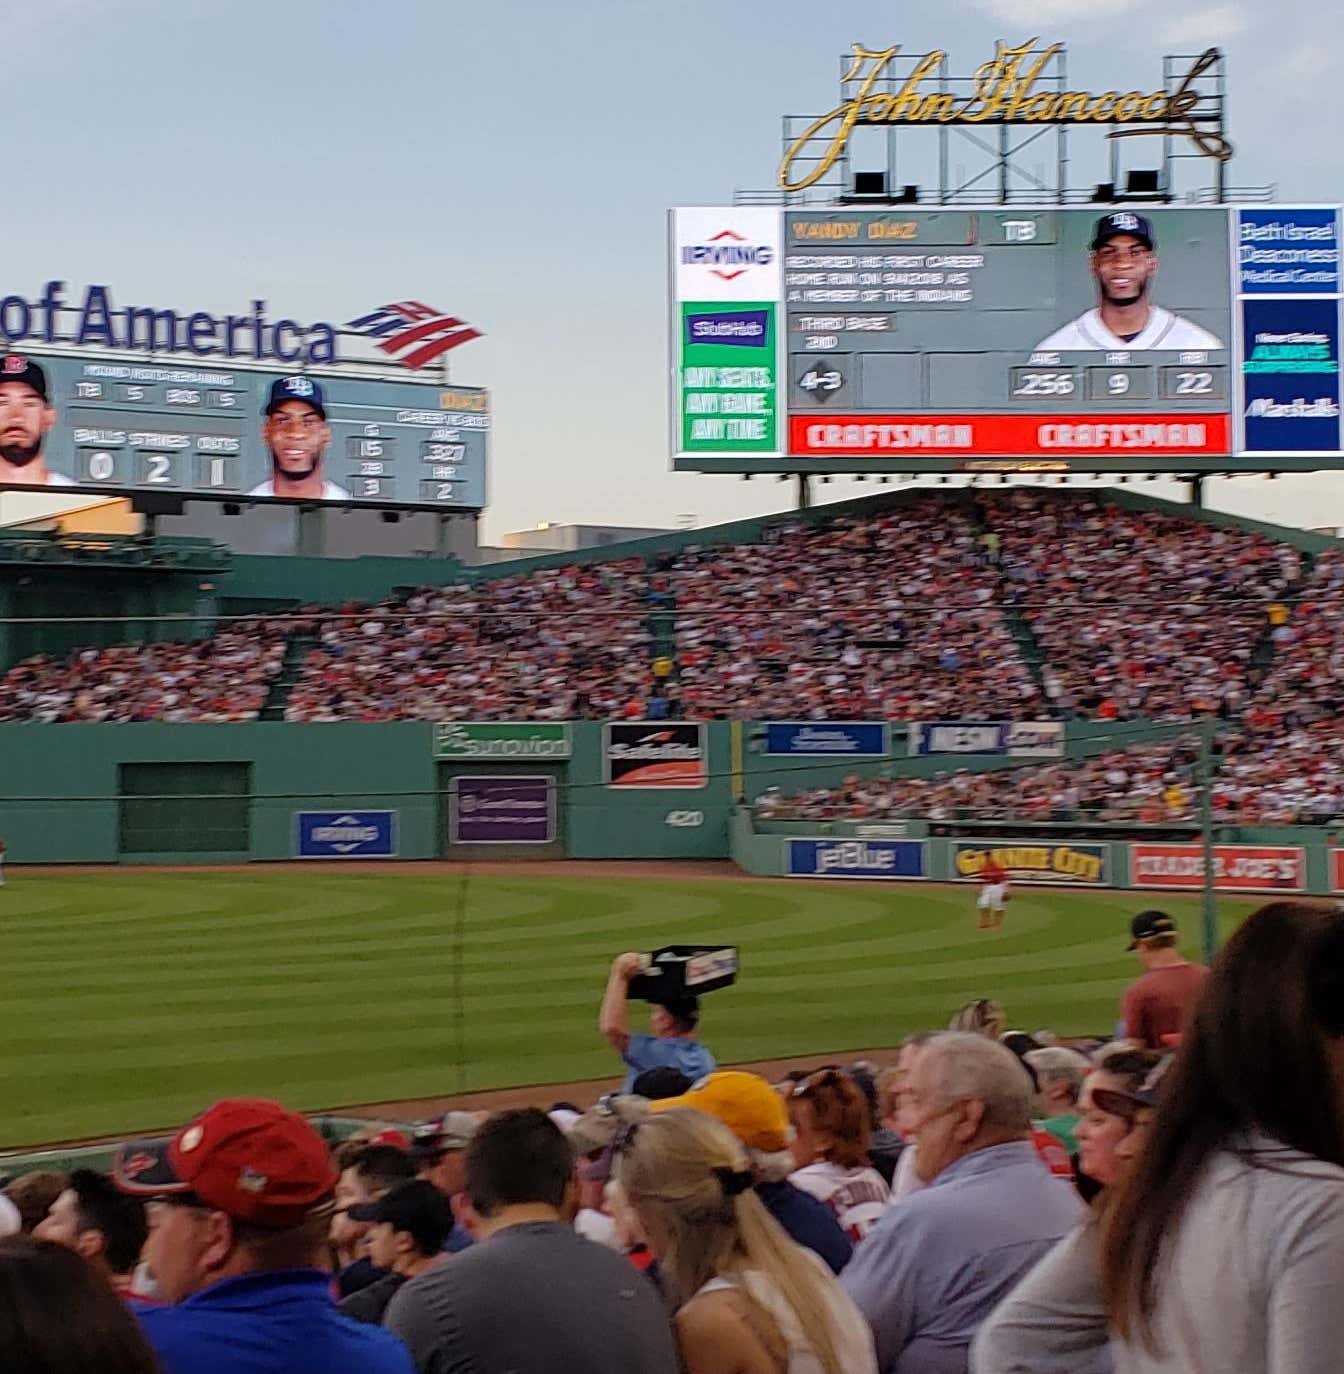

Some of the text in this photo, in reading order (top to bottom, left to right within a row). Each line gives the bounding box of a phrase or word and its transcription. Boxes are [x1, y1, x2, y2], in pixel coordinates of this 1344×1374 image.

[778, 37, 1234, 191] John Hancock
[1001, 219, 1038, 241] TB
[681, 245, 775, 265] IRVING
[73, 284, 343, 366] America
[798, 371, 843, 392] 4-3
[1107, 373, 1131, 395] 9
[1175, 372, 1214, 394] 22
[127, 386, 145, 401] 5
[218, 392, 237, 408] 5
[805, 423, 1207, 449] CRAFTSMAN CRAFTSMAN
[360, 440, 384, 458] 15
[88, 452, 226, 487] 0 2 1
[363, 479, 454, 501] 3 2
[815, 841, 897, 873] jetBlue
